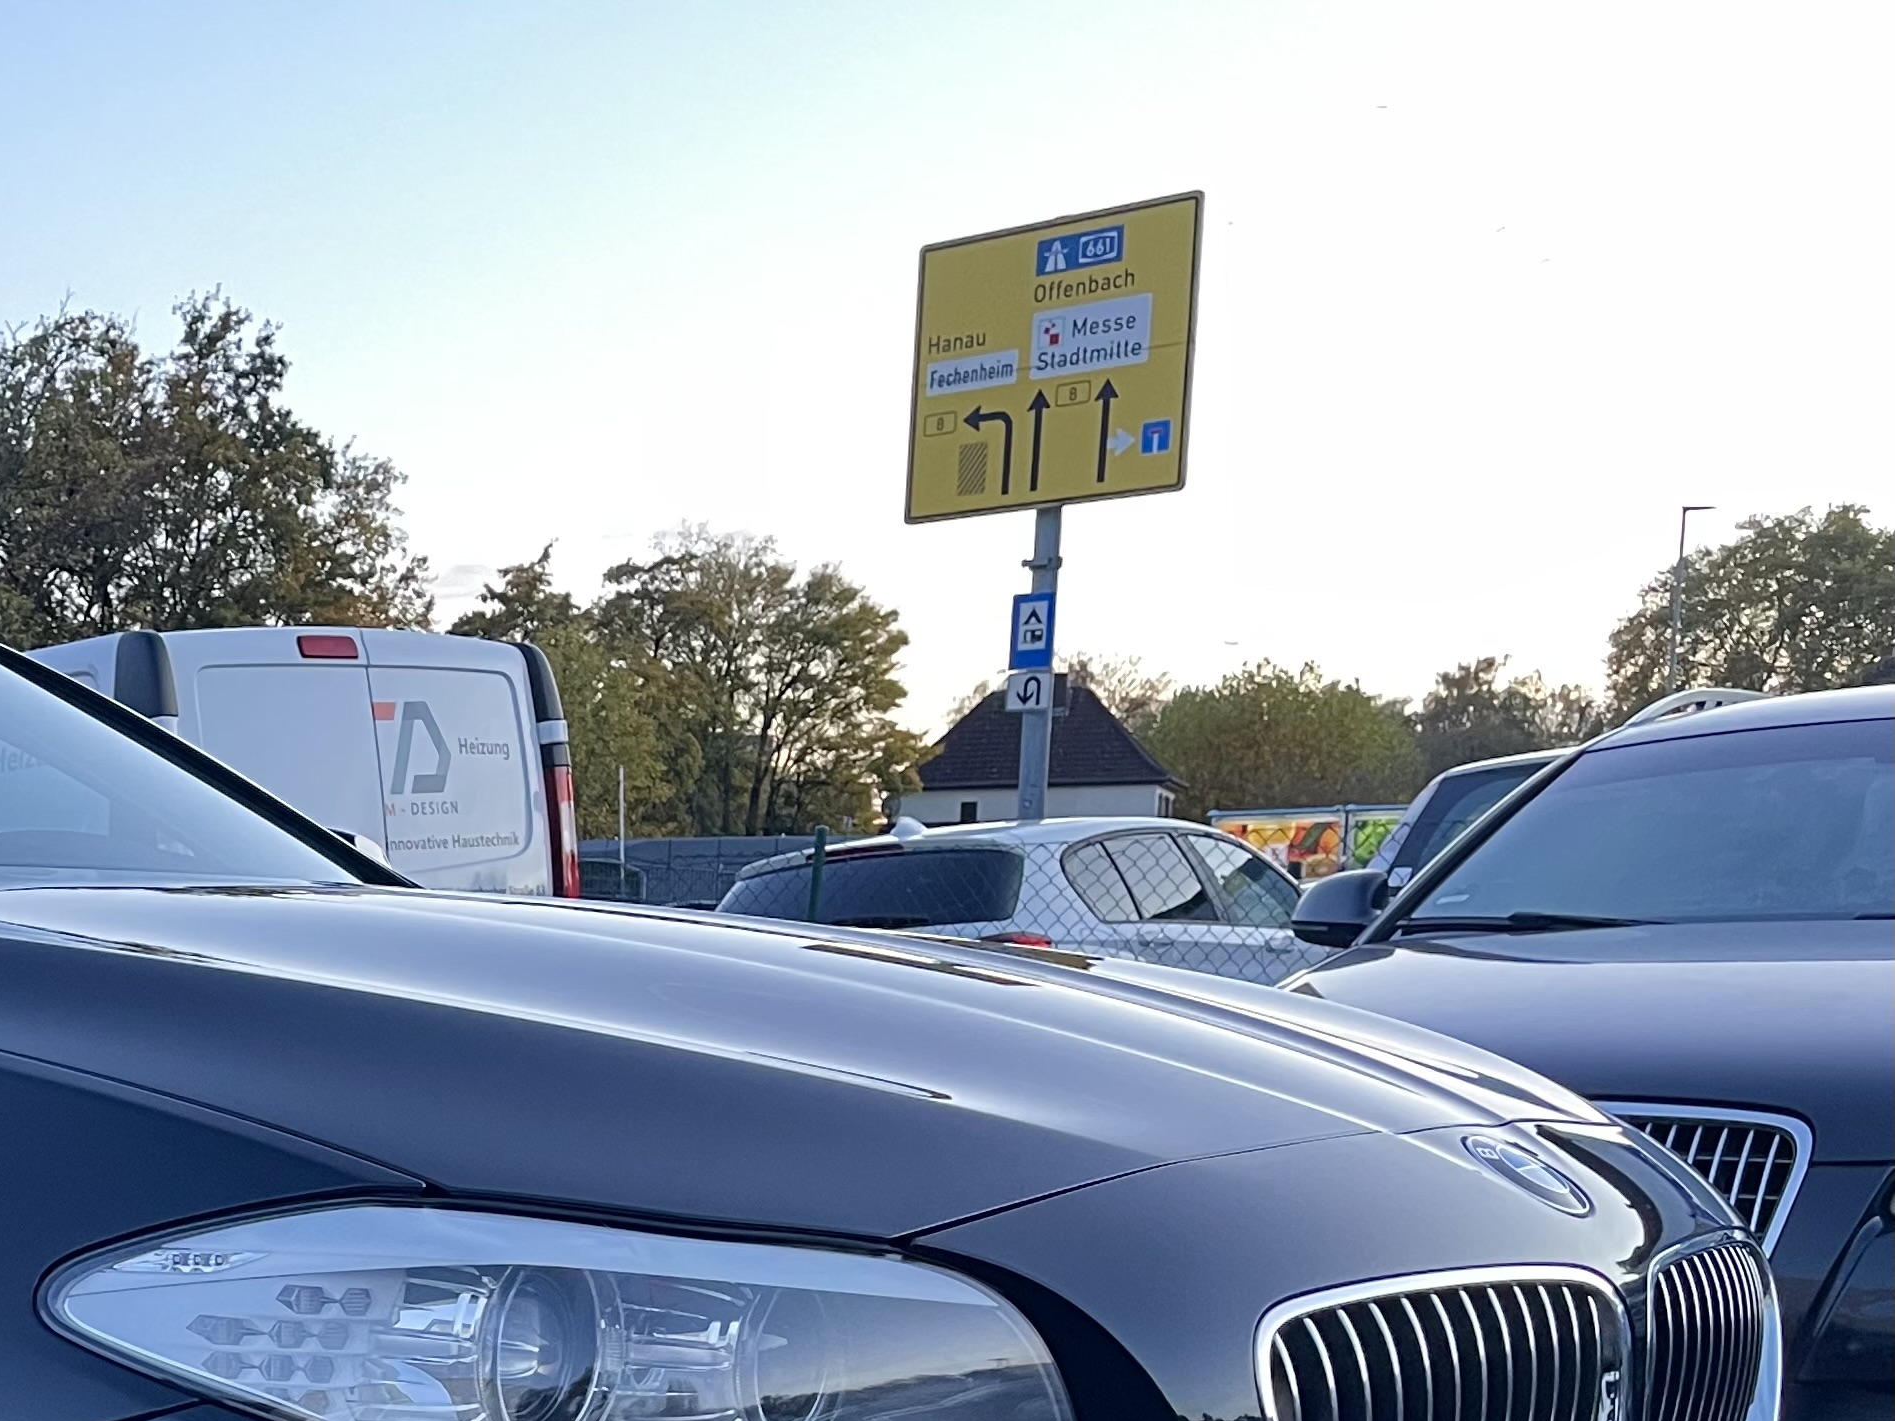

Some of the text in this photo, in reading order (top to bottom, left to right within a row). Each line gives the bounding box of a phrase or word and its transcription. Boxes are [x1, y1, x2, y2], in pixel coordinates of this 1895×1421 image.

[1086, 238, 1111, 257] 661
[1034, 267, 1135, 303] Offenbach
[1071, 315, 1137, 338] Messe
[928, 332, 986, 355] Hanau
[1036, 339, 1142, 371] Stadtmitte
[929, 359, 1014, 390] Fechenheim
[457, 737, 510, 760] Heizung
[410, 801, 460, 816] DESIGN
[451, 831, 520, 849] Haustechnik
